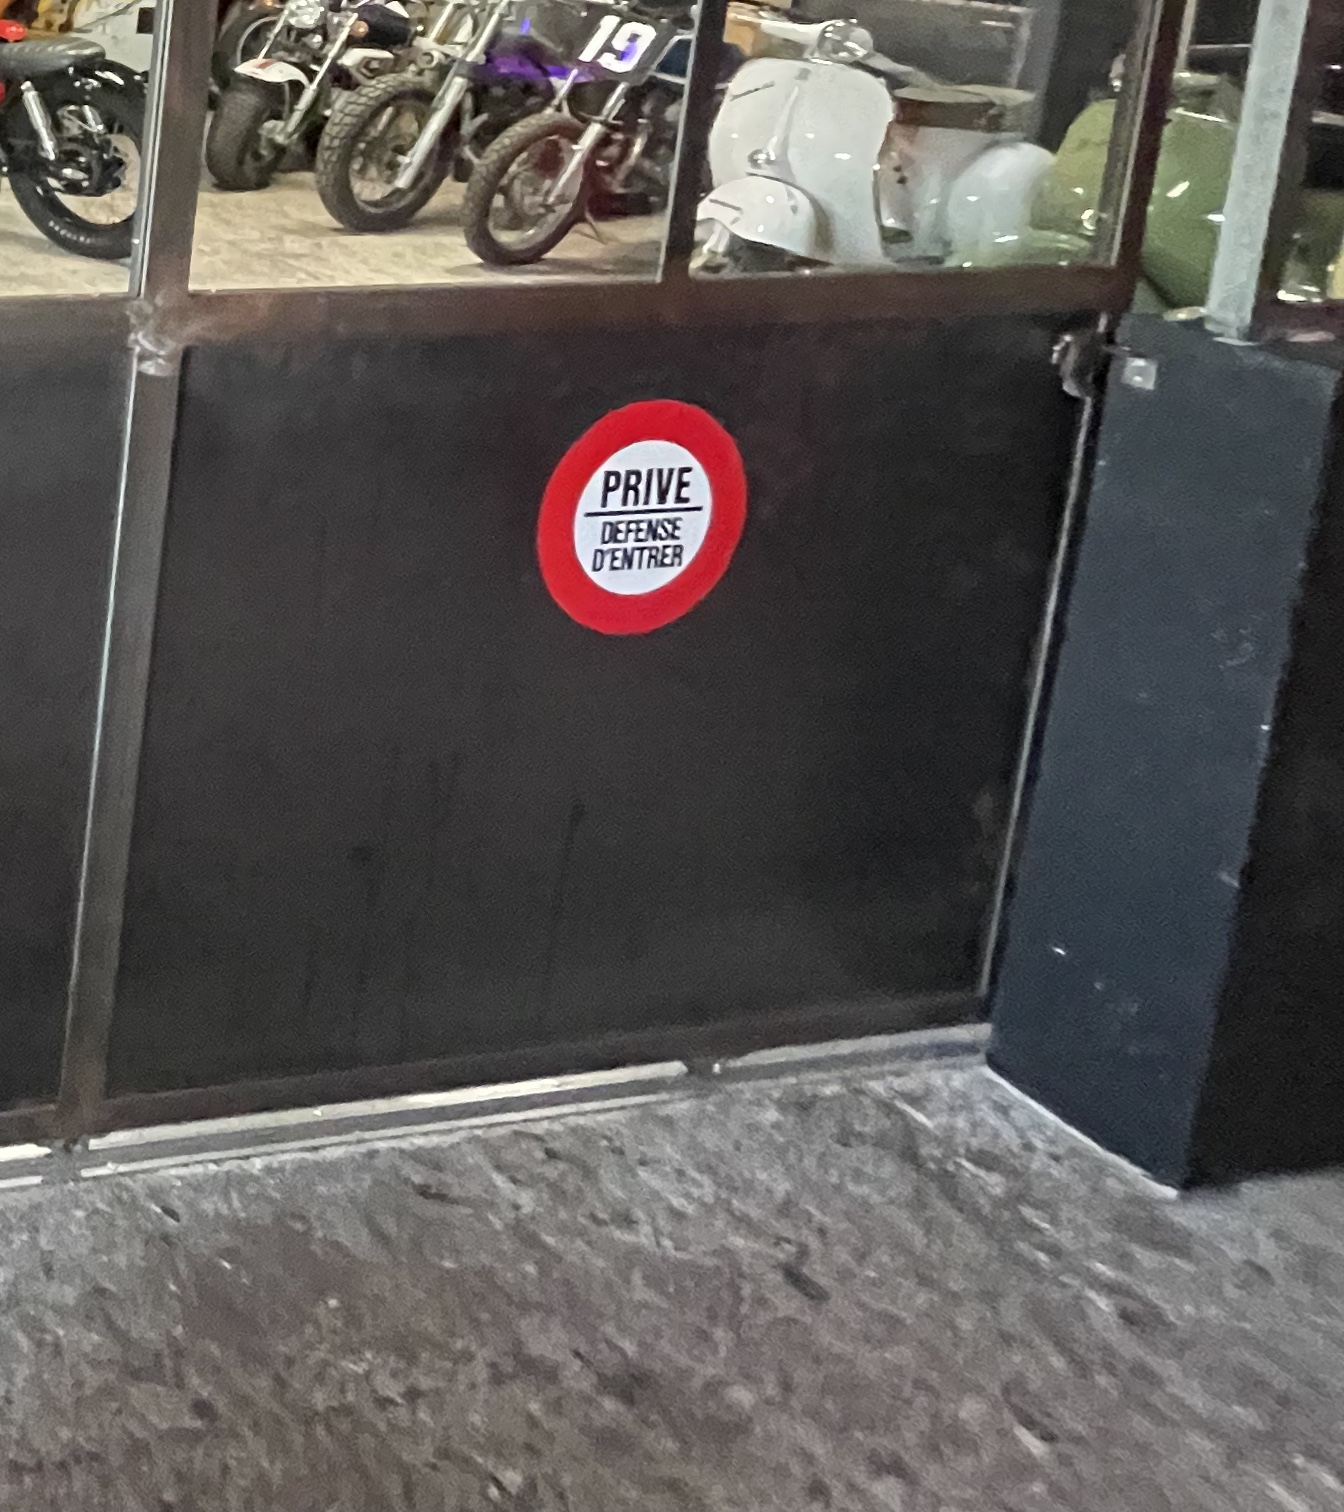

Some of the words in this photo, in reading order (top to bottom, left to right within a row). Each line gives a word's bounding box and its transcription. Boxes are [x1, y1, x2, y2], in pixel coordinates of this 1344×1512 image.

[577, 14, 659, 74] 19
[600, 466, 693, 508] PRIVE
[600, 517, 683, 545] DEFENSE
[591, 544, 685, 572] D'ENTRER
